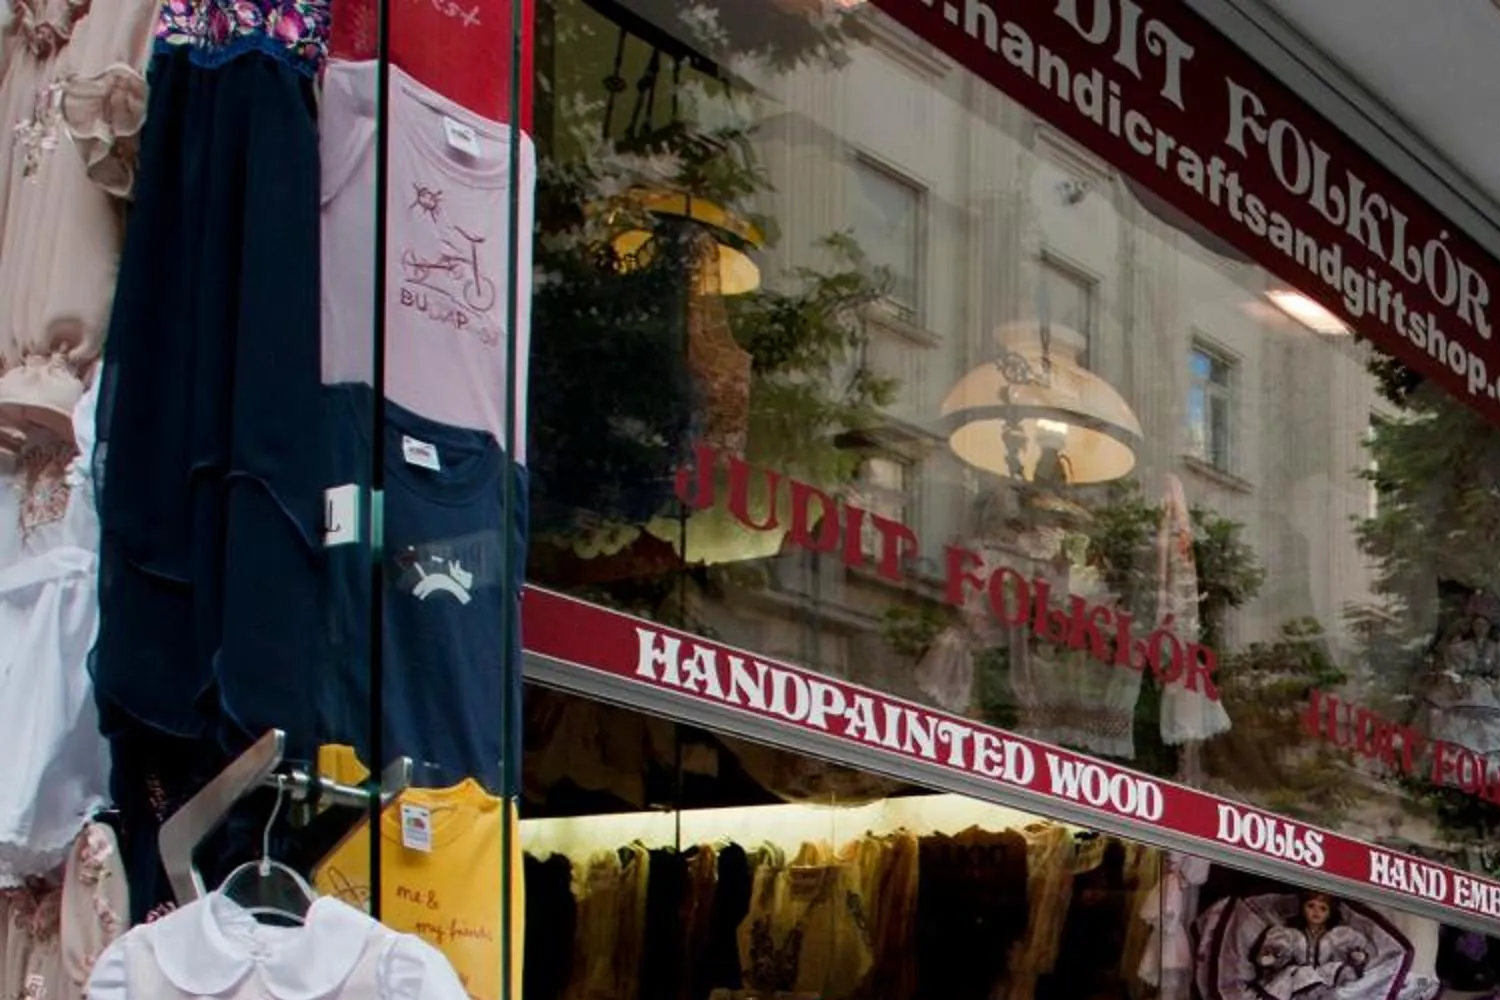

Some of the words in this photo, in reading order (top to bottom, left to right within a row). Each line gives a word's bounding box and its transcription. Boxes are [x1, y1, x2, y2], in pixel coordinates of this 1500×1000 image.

[1224, 76, 1492, 340] FOLKLÓR
[675, 442, 918, 581] JUDIT
[944, 543, 1223, 701] FOLKLÓR
[634, 626, 1035, 787] HANDPAINTED
[1045, 751, 1165, 822] WOOD
[1216, 803, 1325, 869] DOLLS
[1369, 849, 1447, 902] HAND
